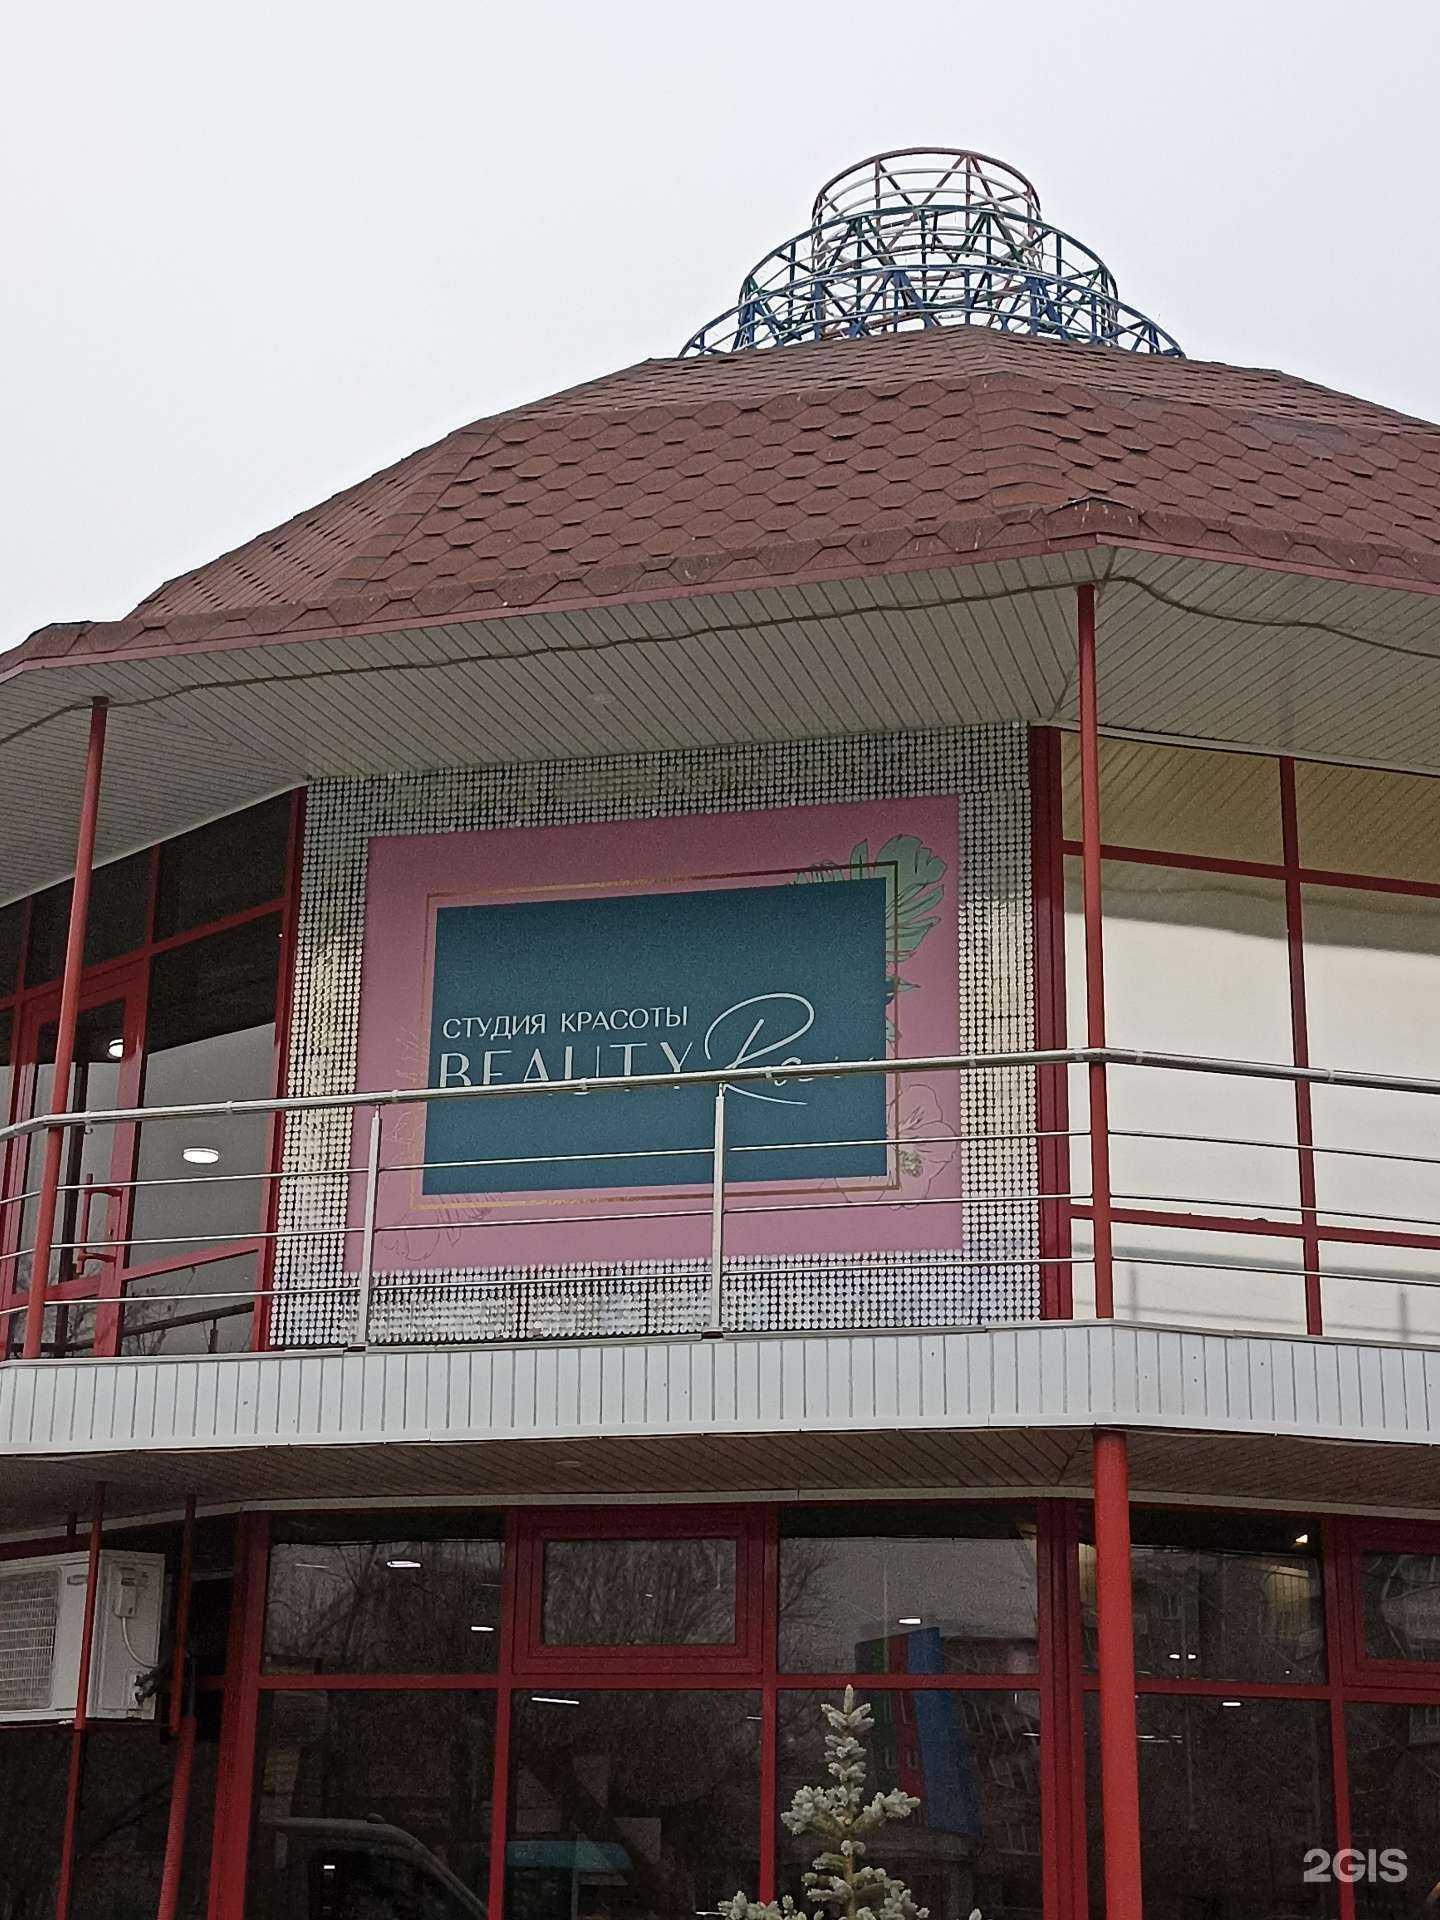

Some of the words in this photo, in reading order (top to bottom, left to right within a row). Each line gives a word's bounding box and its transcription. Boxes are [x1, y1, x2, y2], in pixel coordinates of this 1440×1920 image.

[442, 1013, 546, 1041] СТУДИЯ
[561, 1006, 688, 1032] КРАСОТЫ
[439, 1041, 694, 1096] BEAUTY
